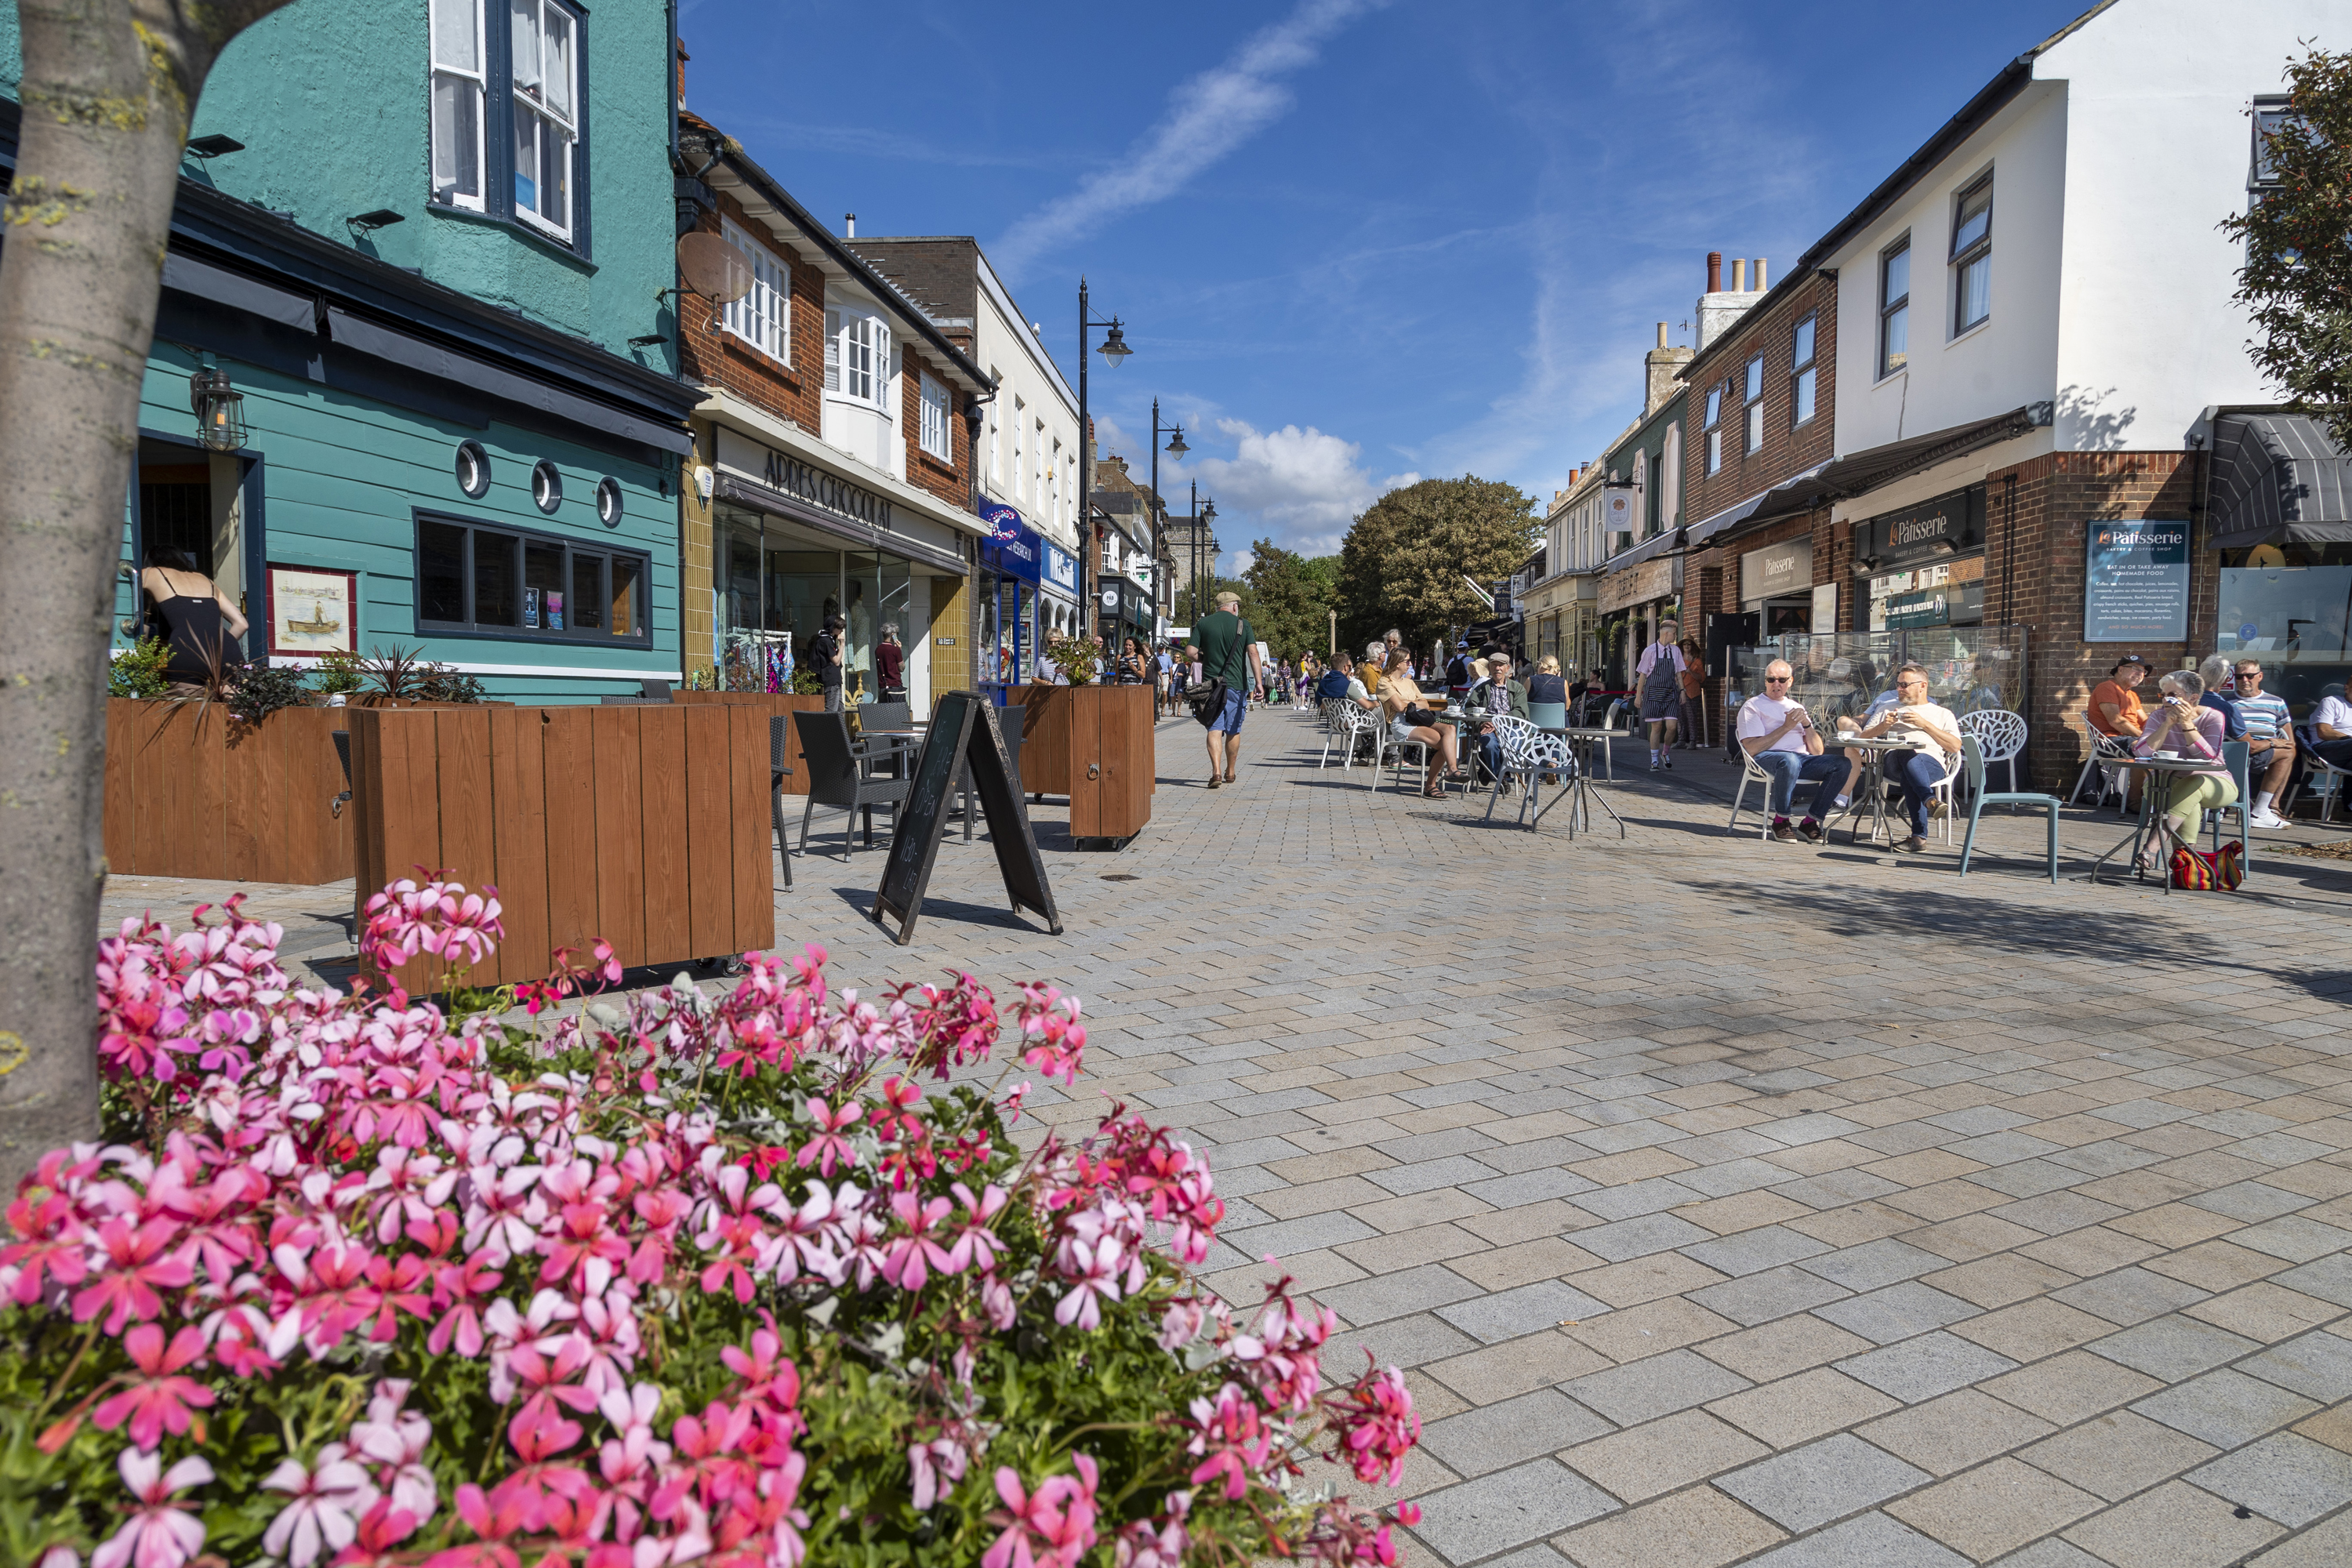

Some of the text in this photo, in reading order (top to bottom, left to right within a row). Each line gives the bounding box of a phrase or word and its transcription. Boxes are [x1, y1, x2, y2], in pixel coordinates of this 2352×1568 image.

[764, 450, 816, 503] APRES
[820, 475, 893, 534] CHOCOLAT
[1888, 511, 1947, 547] La Pâtisserie
[2096, 529, 2183, 545] La Pâtisserie
[1913, 545, 1928, 554] COFFEE
[933, 719, 946, 743] WE
[931, 746, 953, 777] ARE
[916, 786, 939, 818] OPEN
[903, 868, 918, 893] LATE
